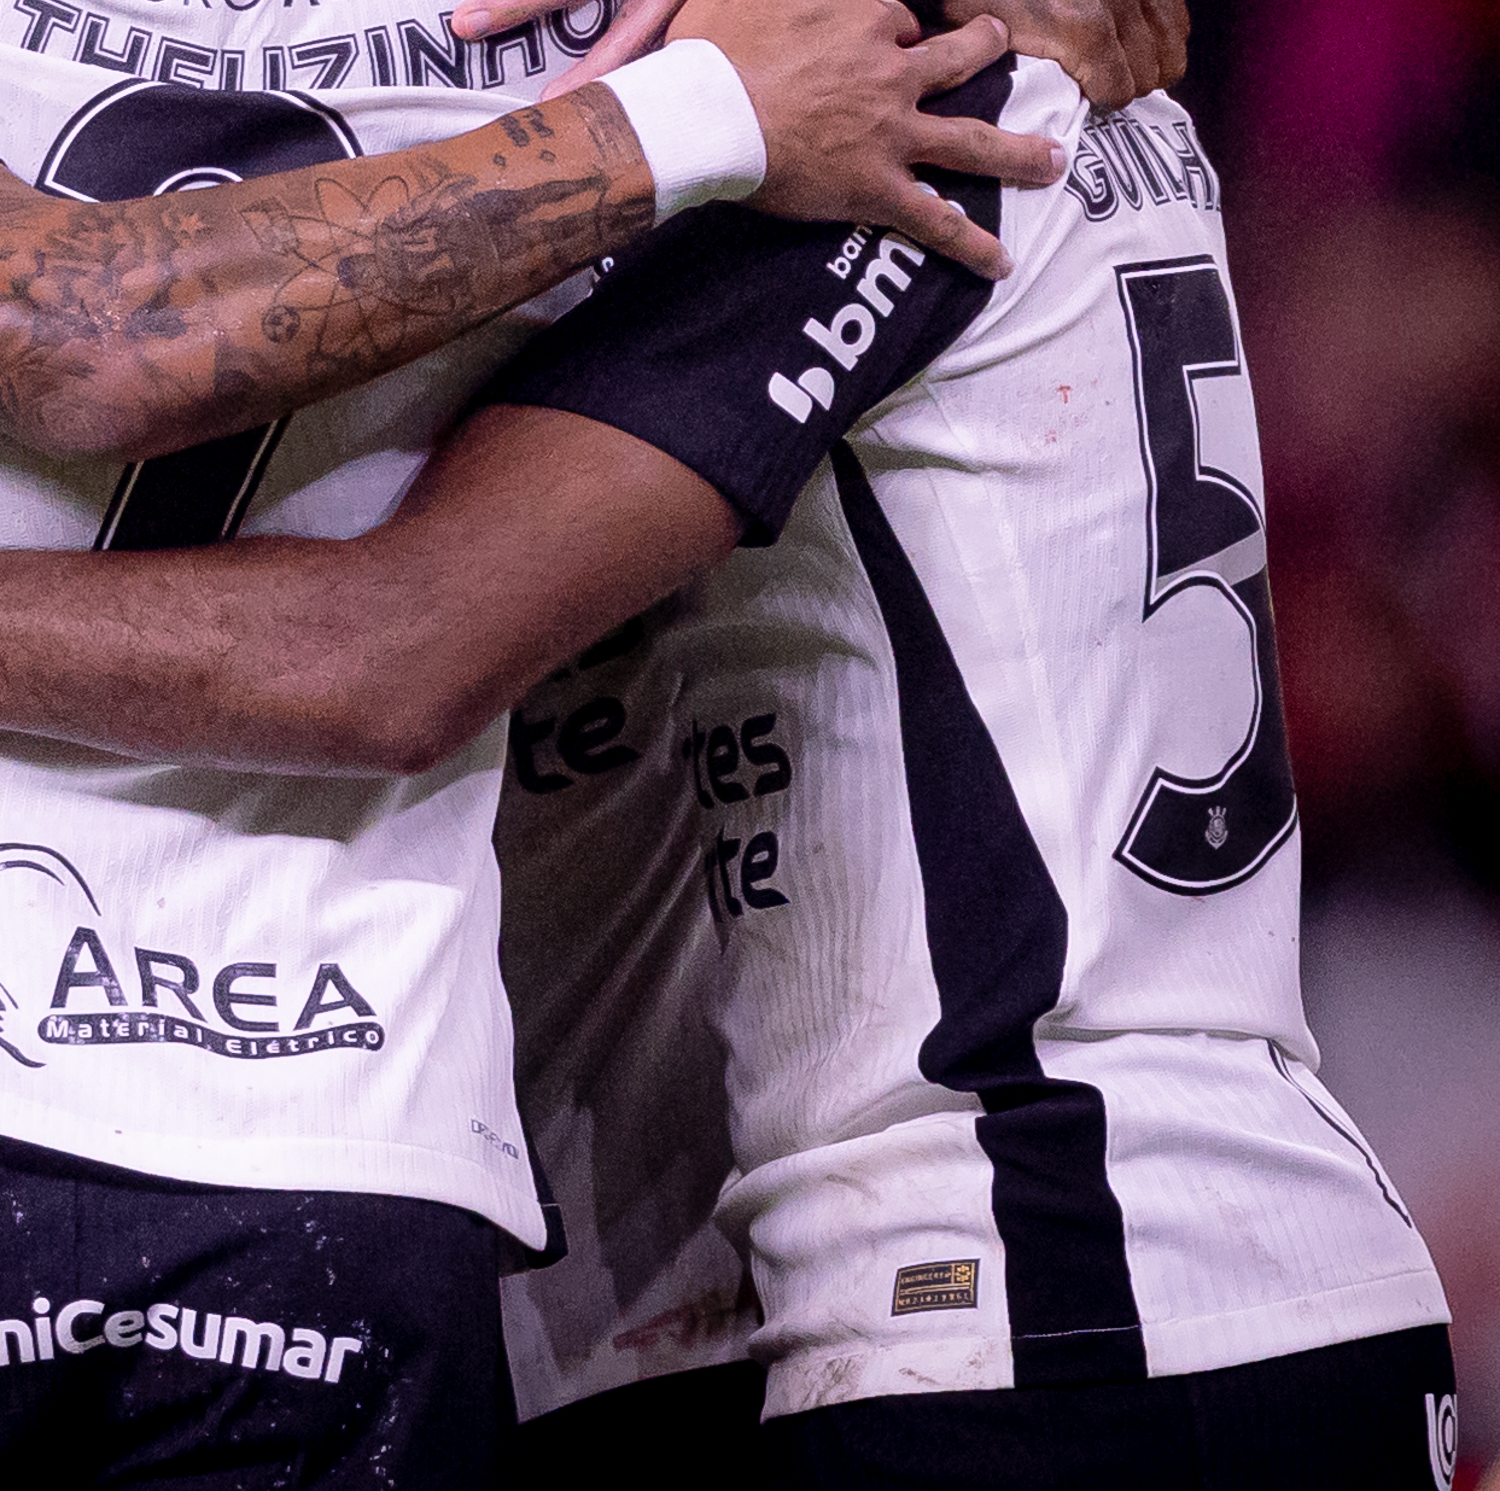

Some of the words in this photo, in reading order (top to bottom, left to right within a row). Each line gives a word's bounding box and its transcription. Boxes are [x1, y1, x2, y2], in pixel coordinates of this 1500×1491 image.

[1063, 109, 1221, 222] GUILH
[803, 181, 966, 372] bm
[825, 224, 873, 280] ban
[1113, 254, 1299, 897] 5
[46, 1012, 203, 1044] Material
[50, 925, 377, 1032] AREA
